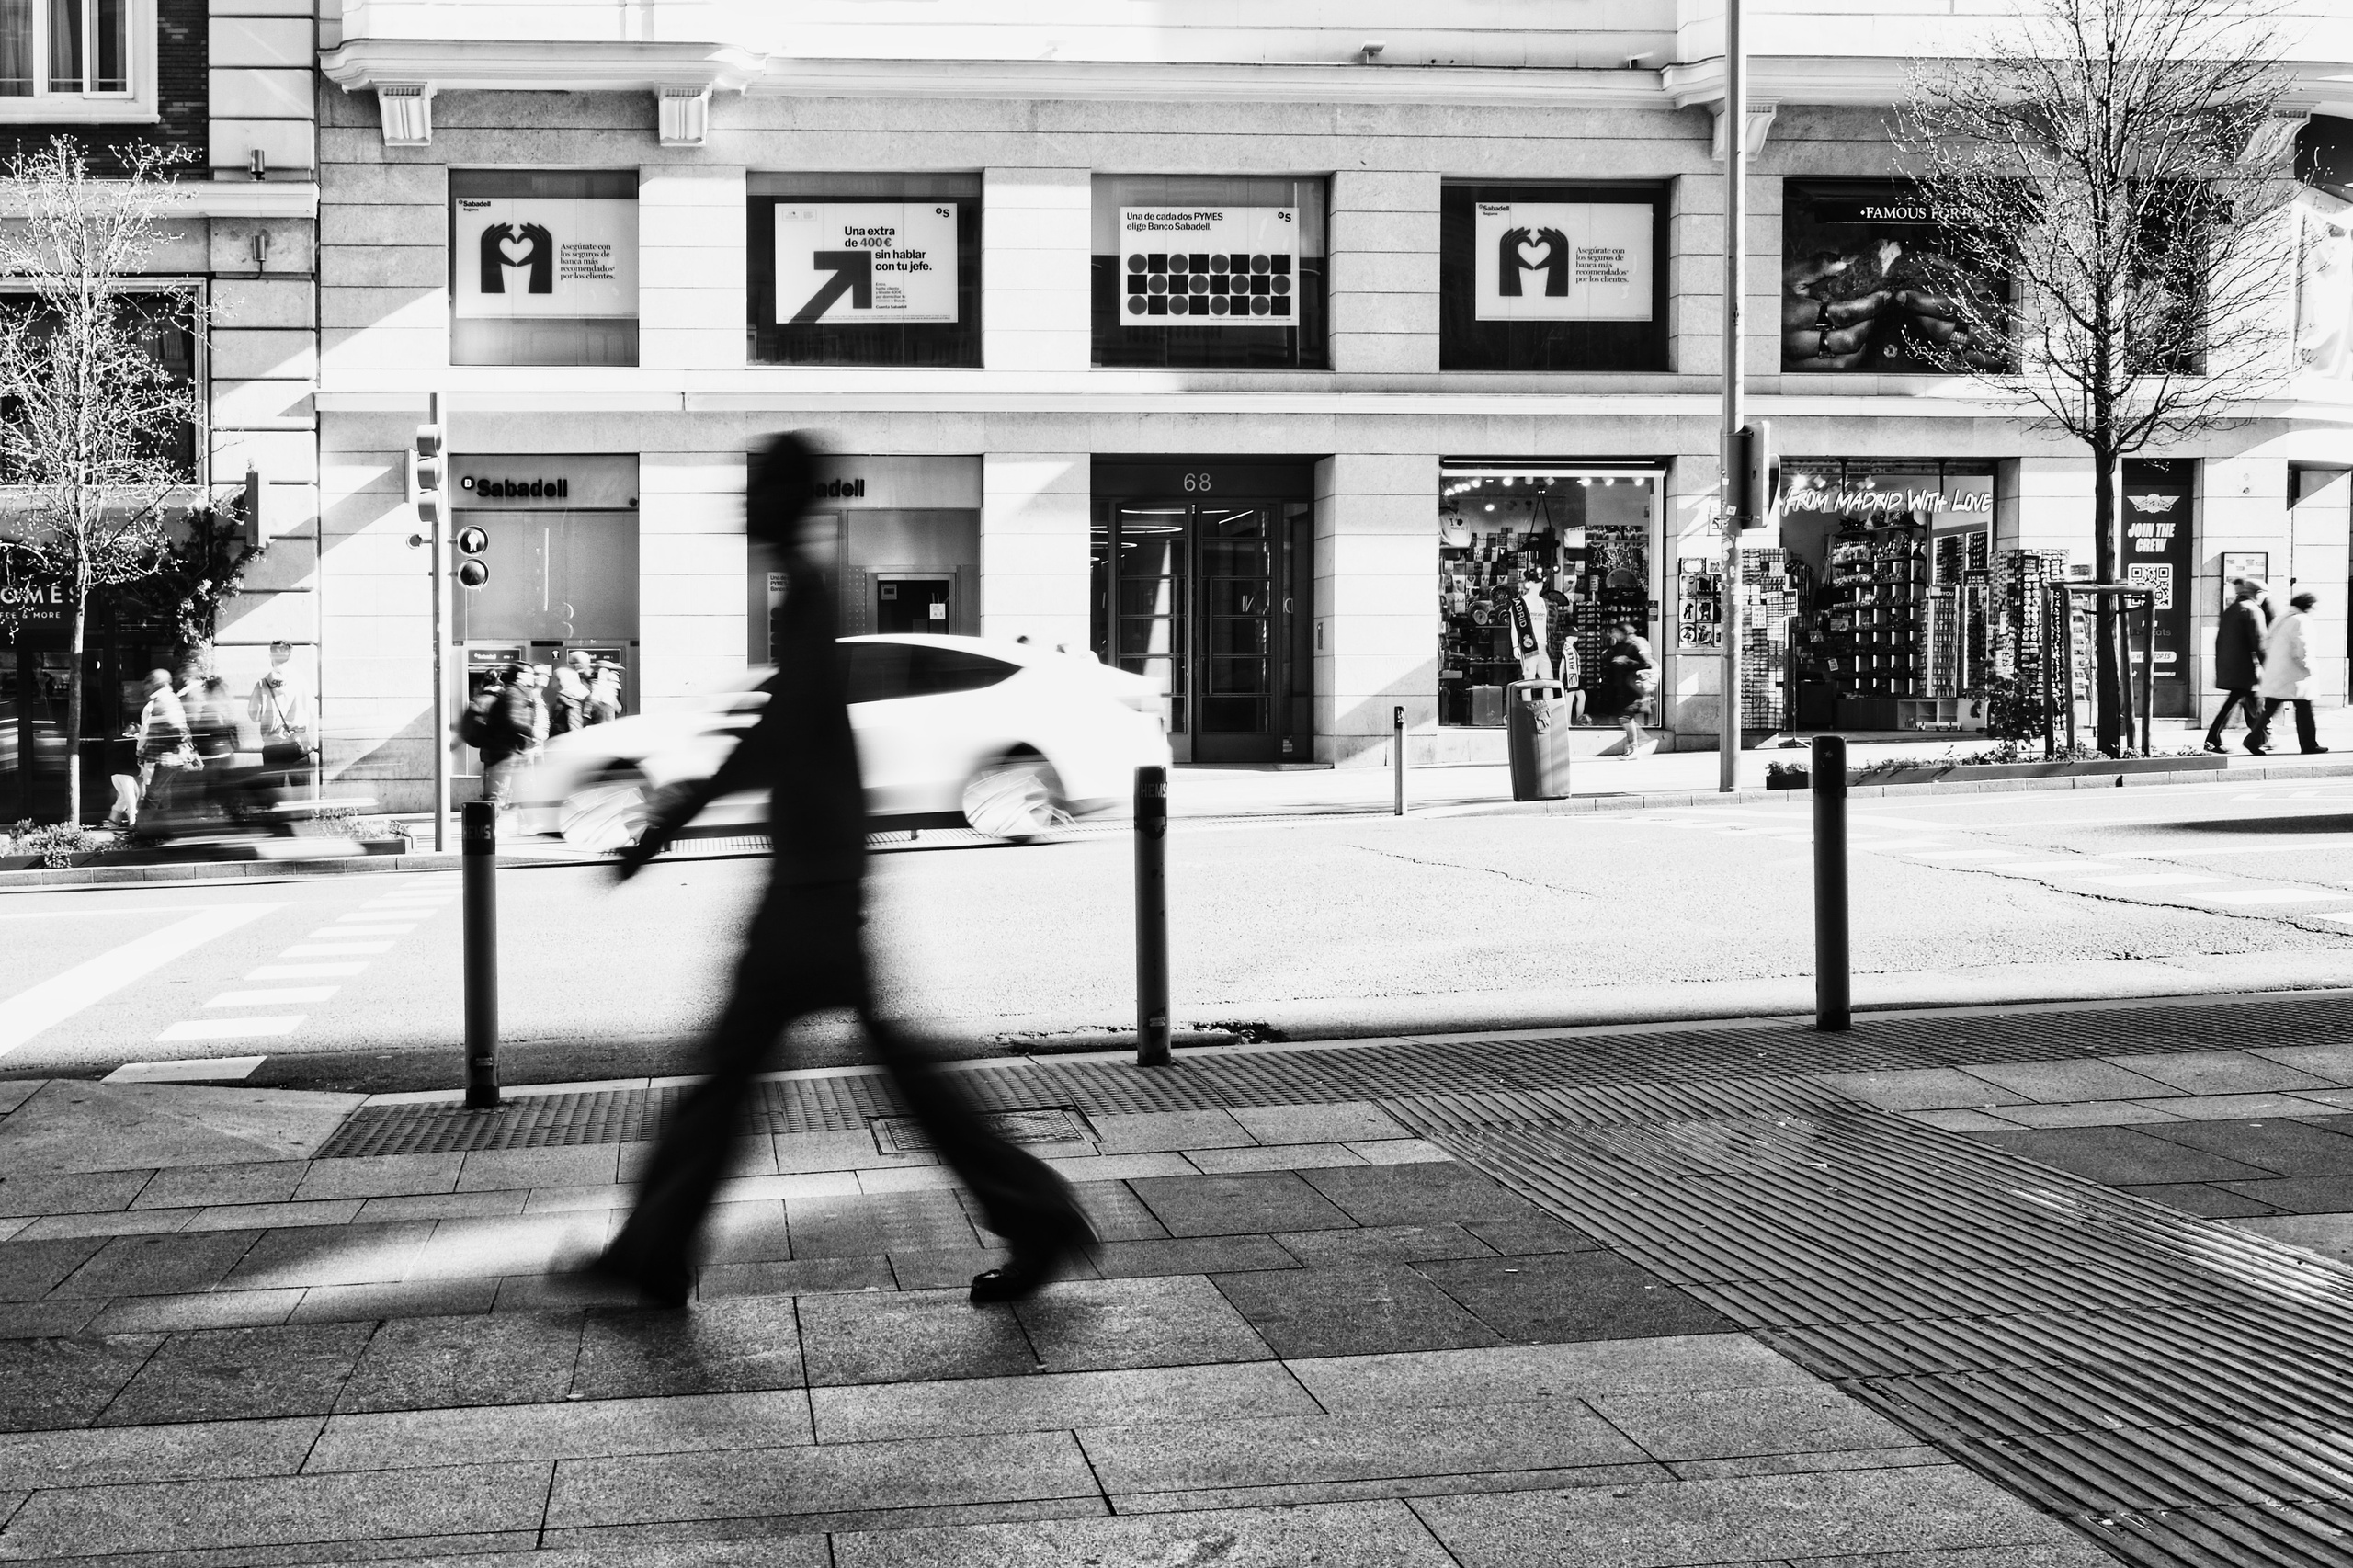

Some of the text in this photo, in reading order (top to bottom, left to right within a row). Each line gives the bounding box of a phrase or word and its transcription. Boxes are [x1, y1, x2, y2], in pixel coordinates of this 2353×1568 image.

[1127, 211, 1223, 221] Una de cada dos PYMES
[1866, 206, 1927, 220] FAMOUS
[845, 225, 896, 236] Una extra
[1127, 222, 1211, 233] elige Banco Sabadell.
[561, 243, 597, 252] Asegúrate
[845, 237, 858, 247] de
[561, 249, 571, 257] los
[601, 249, 610, 257] de
[875, 249, 926, 259] sin hablar
[1576, 246, 1611, 256] Asegúrate
[1576, 253, 1586, 261] los
[1615, 253, 1624, 261] de
[875, 261, 932, 273] con tu jefe.
[575, 271, 585, 279] los
[477, 478, 568, 497] Sabadell
[1183, 472, 1211, 492] 68
[1781, 488, 1993, 517] FROM MADRID WITH LOVE
[2127, 522, 2176, 538] JOIN THE
[2135, 538, 2167, 552] CREW
